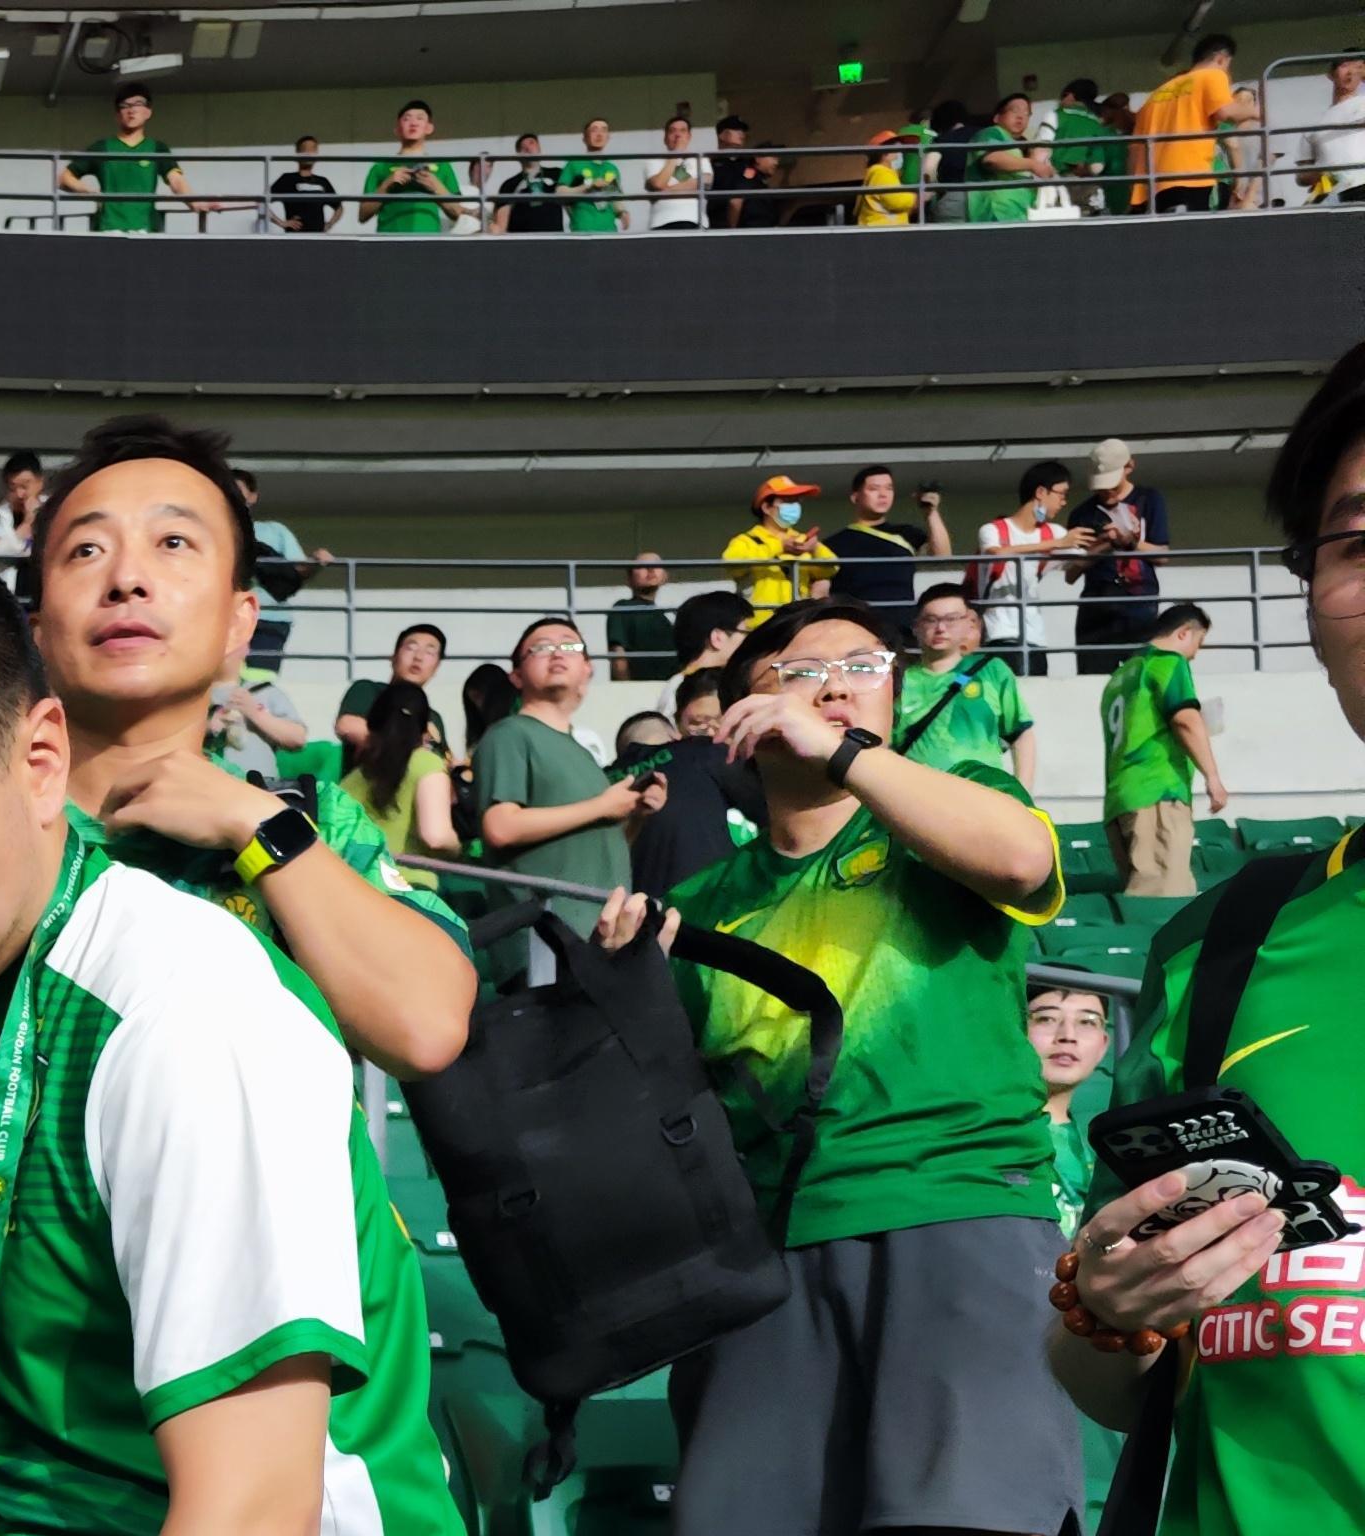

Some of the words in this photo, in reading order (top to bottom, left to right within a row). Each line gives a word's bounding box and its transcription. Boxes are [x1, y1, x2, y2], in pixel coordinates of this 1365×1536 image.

[42, 902, 65, 930] CLUB
[11, 1021, 29, 1066] GUOAN
[0, 1066, 22, 1127] FOOTBALL
[1178, 1122, 1241, 1145] SKULL
[1185, 1130, 1249, 1152] PANDA
[1199, 1308, 1275, 1357] CITIC
[1288, 1304, 1365, 1348] SE
